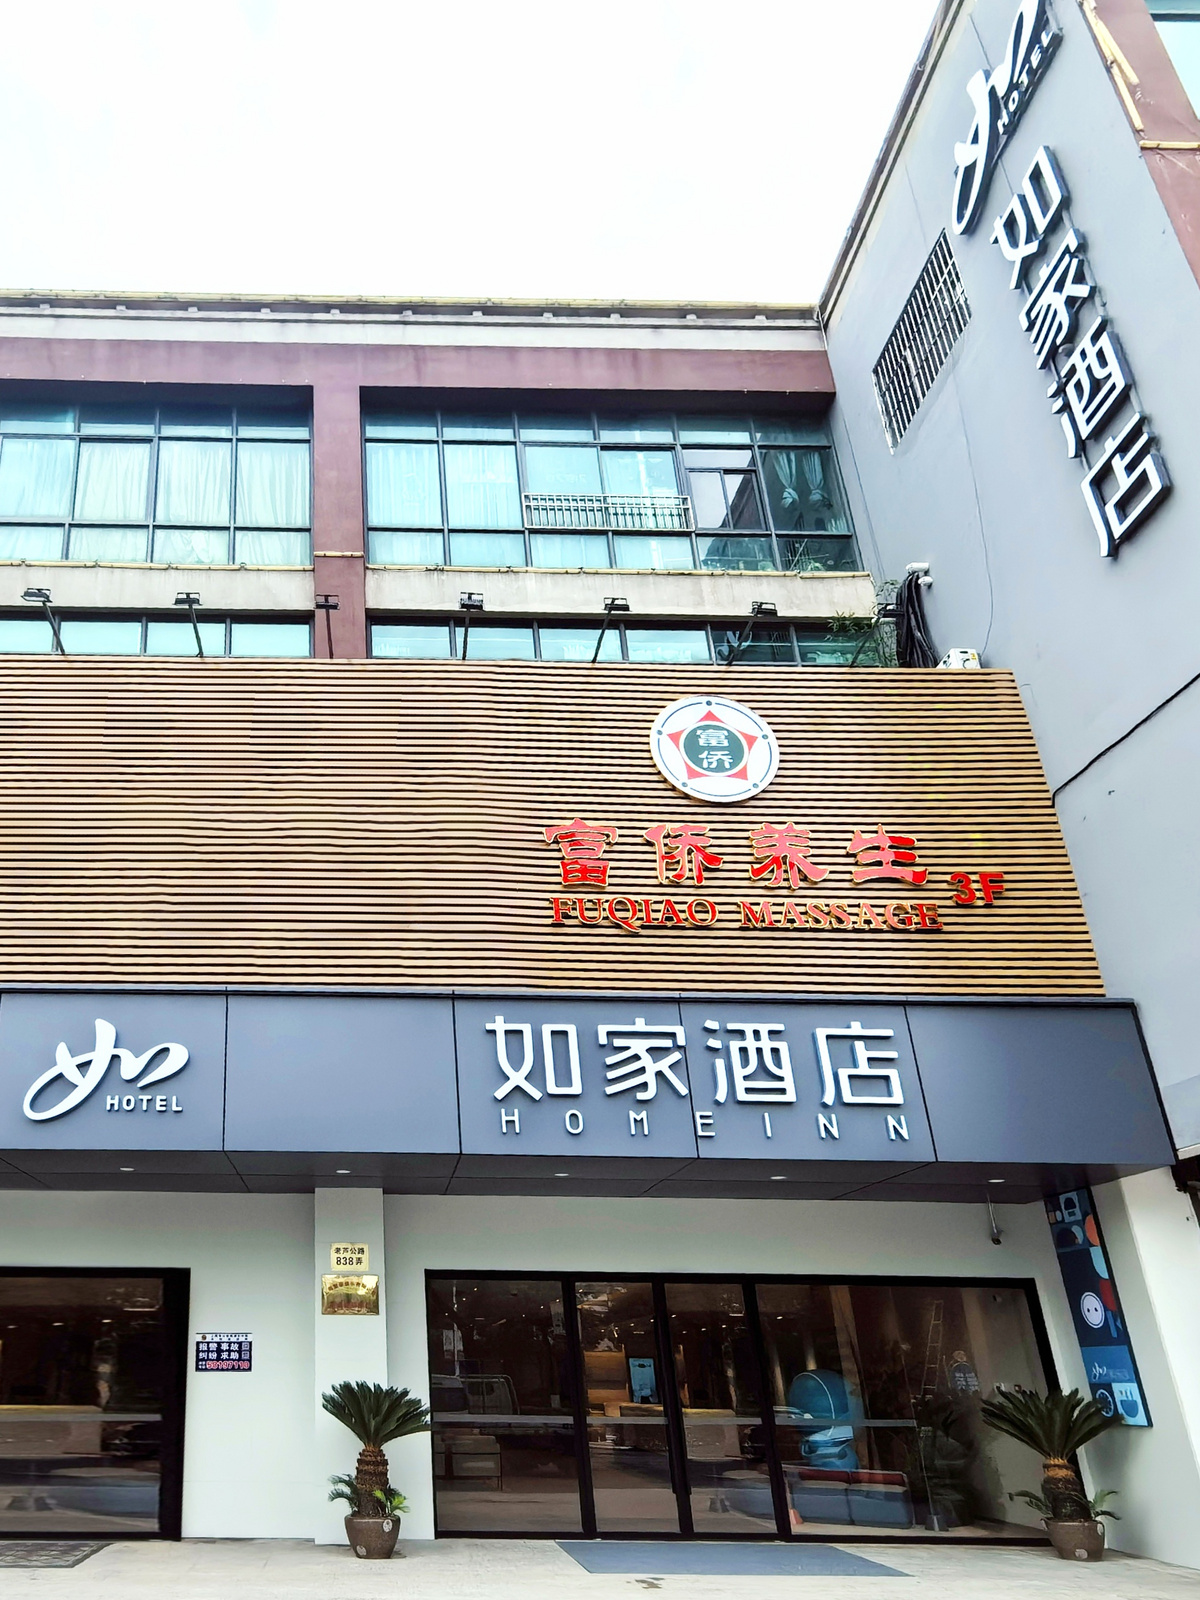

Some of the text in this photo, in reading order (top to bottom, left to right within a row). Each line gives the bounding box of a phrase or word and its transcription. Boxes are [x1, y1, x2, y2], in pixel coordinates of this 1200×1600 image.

[997, 29, 1059, 135] HOTEL
[990, 145, 1167, 558] 如家酒店
[696, 729, 734, 769] 富侨
[542, 817, 929, 890] 富侨养生
[551, 896, 944, 934] FUQIAO MASSAGE
[949, 871, 1005, 905] 3F
[485, 1015, 905, 1107] 如家酒店
[106, 1095, 184, 1113] HOTEL
